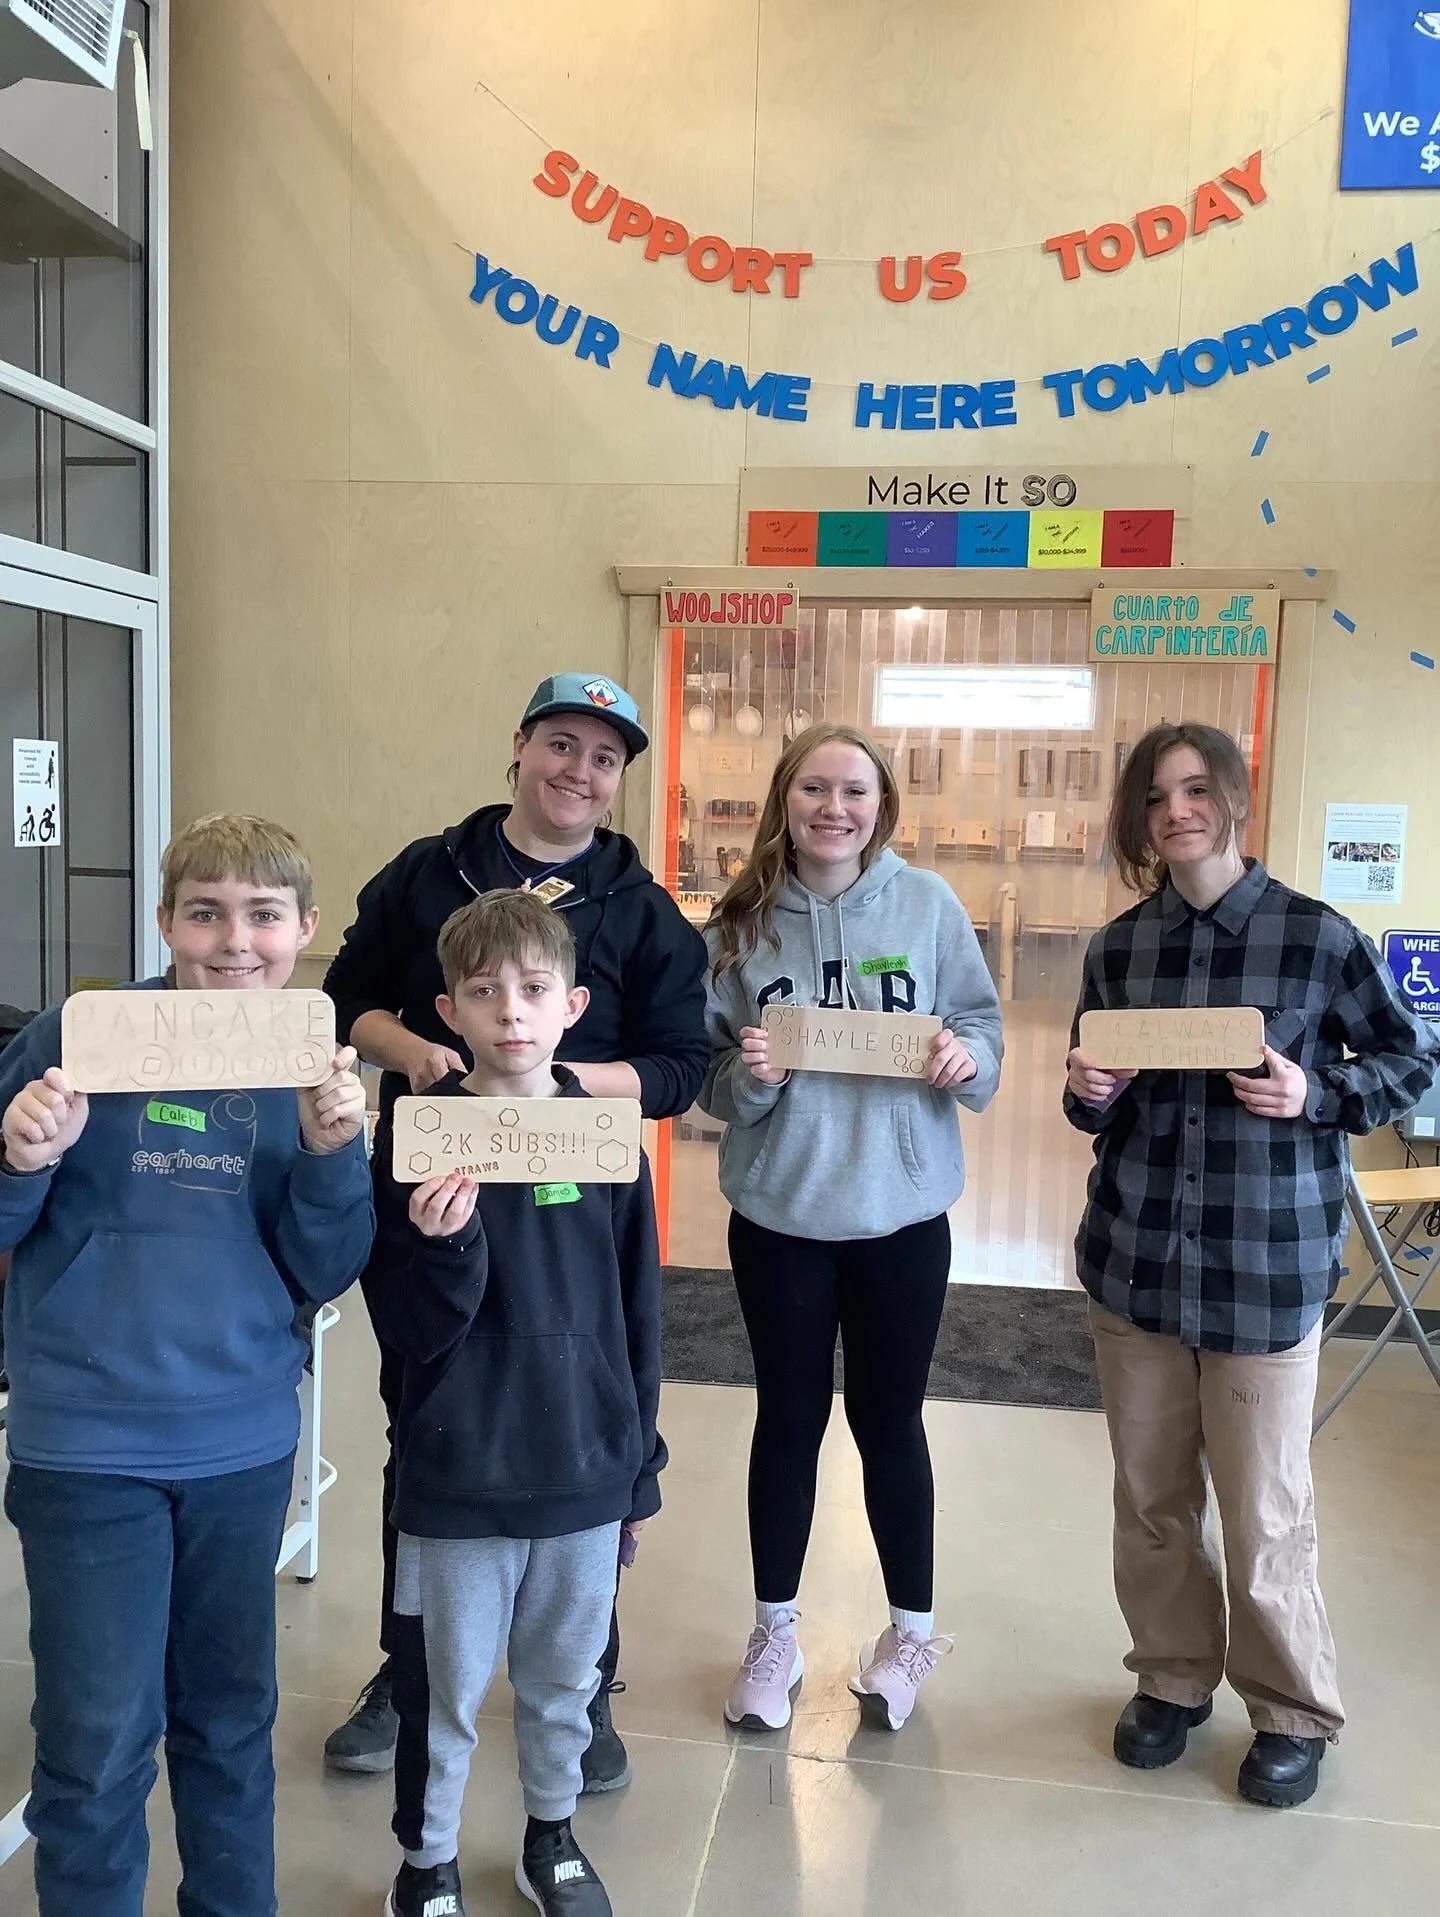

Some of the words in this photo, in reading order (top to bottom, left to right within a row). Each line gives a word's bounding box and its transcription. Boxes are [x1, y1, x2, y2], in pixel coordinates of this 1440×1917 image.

[1363, 111, 1420, 137] We
[533, 150, 813, 299] SUPPORT
[879, 251, 968, 303] US
[1045, 149, 1268, 281] TODAY
[469, 252, 621, 369] YOUR
[647, 342, 812, 422] NAME
[855, 380, 1018, 431] HERE
[1043, 242, 1420, 418] TOMORROW
[867, 474, 971, 506] Make
[984, 475, 1009, 505] It
[1020, 474, 1078, 507] SO
[71, 1000, 331, 1042] PANCAKE
[159, 1104, 198, 1126] Caleb
[441, 1132, 473, 1156] 2K
[490, 1132, 587, 1155] SUBS!!!
[132, 1148, 245, 1176] carhartt
[554, 1860, 585, 1884] NIKE
[422, 1895, 457, 1917] NIKE
